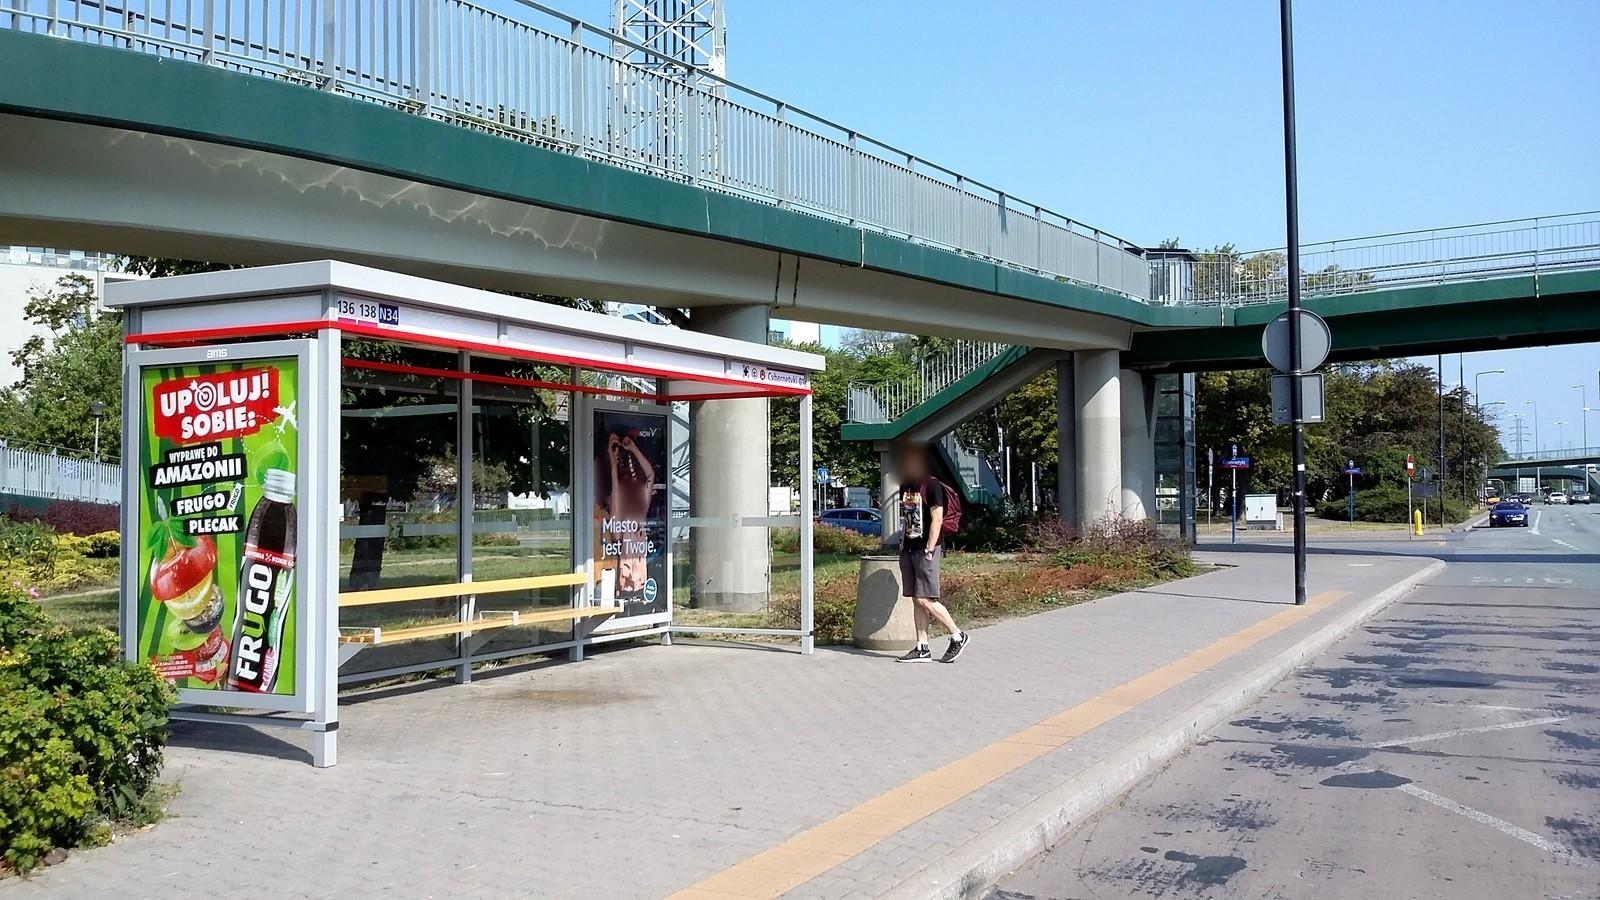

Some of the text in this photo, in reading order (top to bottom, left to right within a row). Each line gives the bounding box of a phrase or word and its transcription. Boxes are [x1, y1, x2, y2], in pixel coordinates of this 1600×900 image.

[337, 300, 399, 323] 136 138 N34
[207, 348, 228, 359] ams
[181, 406, 256, 439] SOBIE:
[169, 446, 218, 463] WYPRAWĘ DO
[154, 458, 242, 486] AMAZONII
[176, 493, 226, 515] FRUGO
[189, 517, 239, 534] PLECAK
[602, 516, 639, 534] Miasto
[601, 536, 657, 560] jest Twoje.
[235, 563, 273, 680] FRUGO
